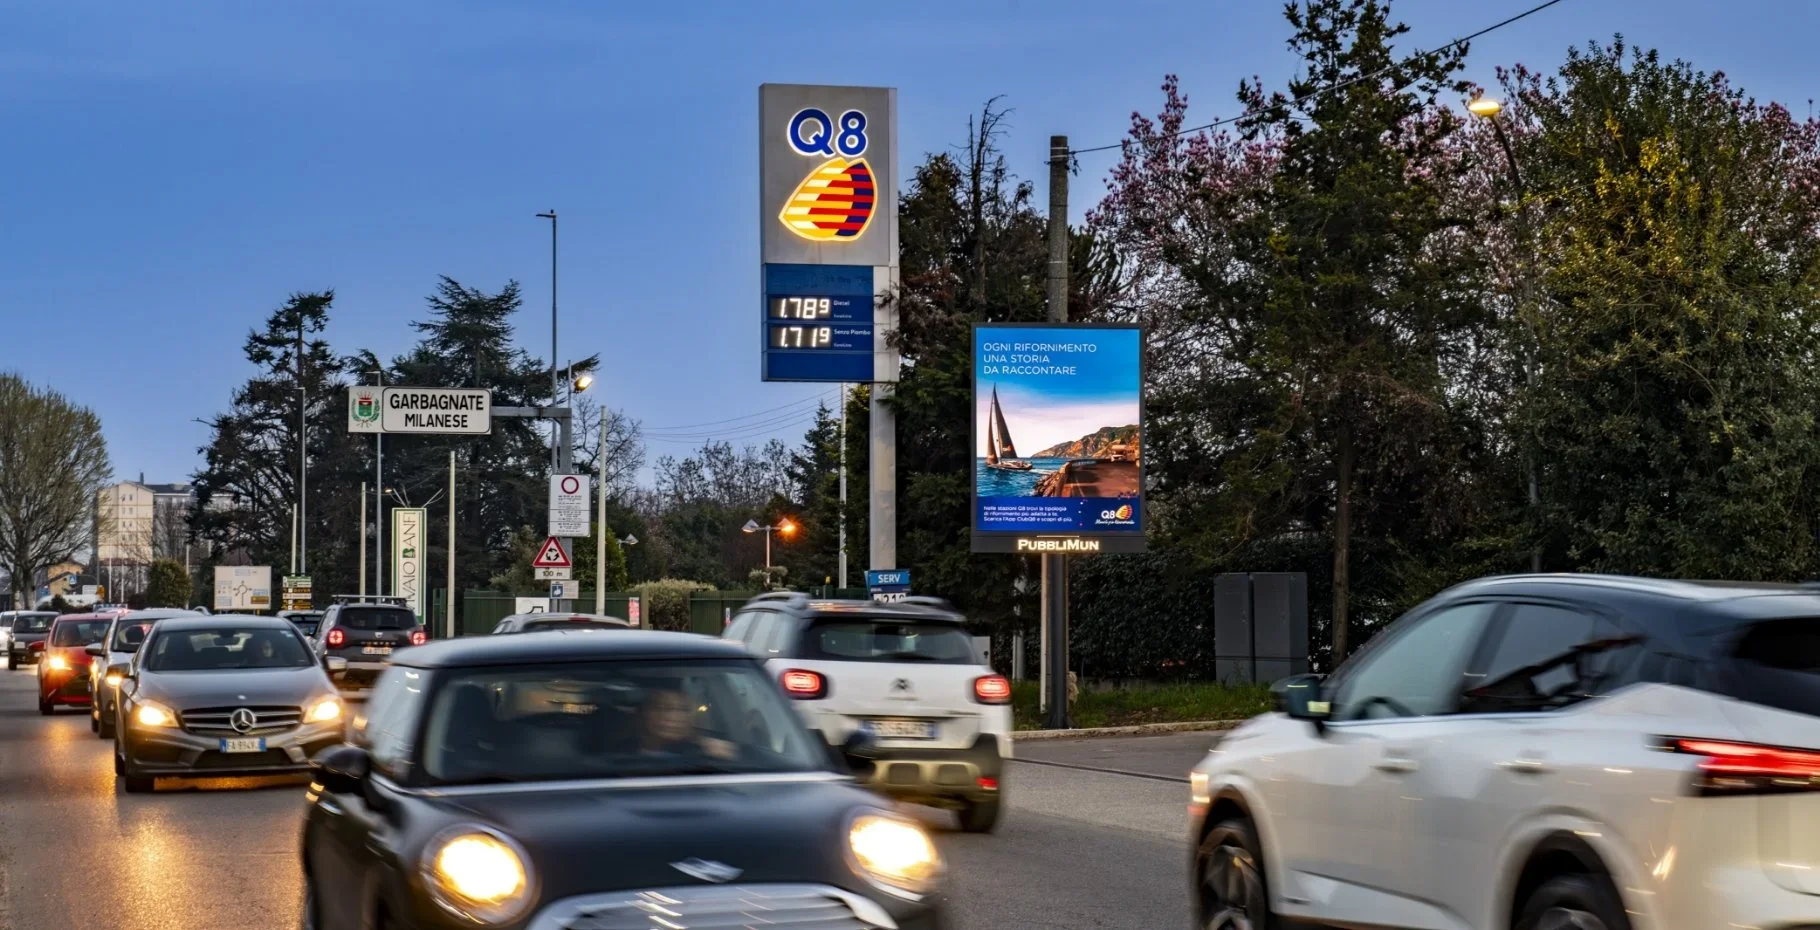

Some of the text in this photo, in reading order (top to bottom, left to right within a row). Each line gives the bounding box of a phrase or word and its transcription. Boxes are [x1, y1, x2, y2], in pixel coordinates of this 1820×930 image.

[787, 107, 868, 157] Q8
[983, 342, 1097, 352] OGNI RIFORNIMENTO
[983, 354, 1050, 363] UNA STORIA
[983, 365, 1076, 375] DA RACCONTARE
[390, 393, 484, 410] GARBAGNATE
[404, 413, 468, 428] MILANESE
[1101, 510, 1116, 519] Q8
[402, 512, 416, 559] BANFI
[877, 573, 901, 584] SERV
